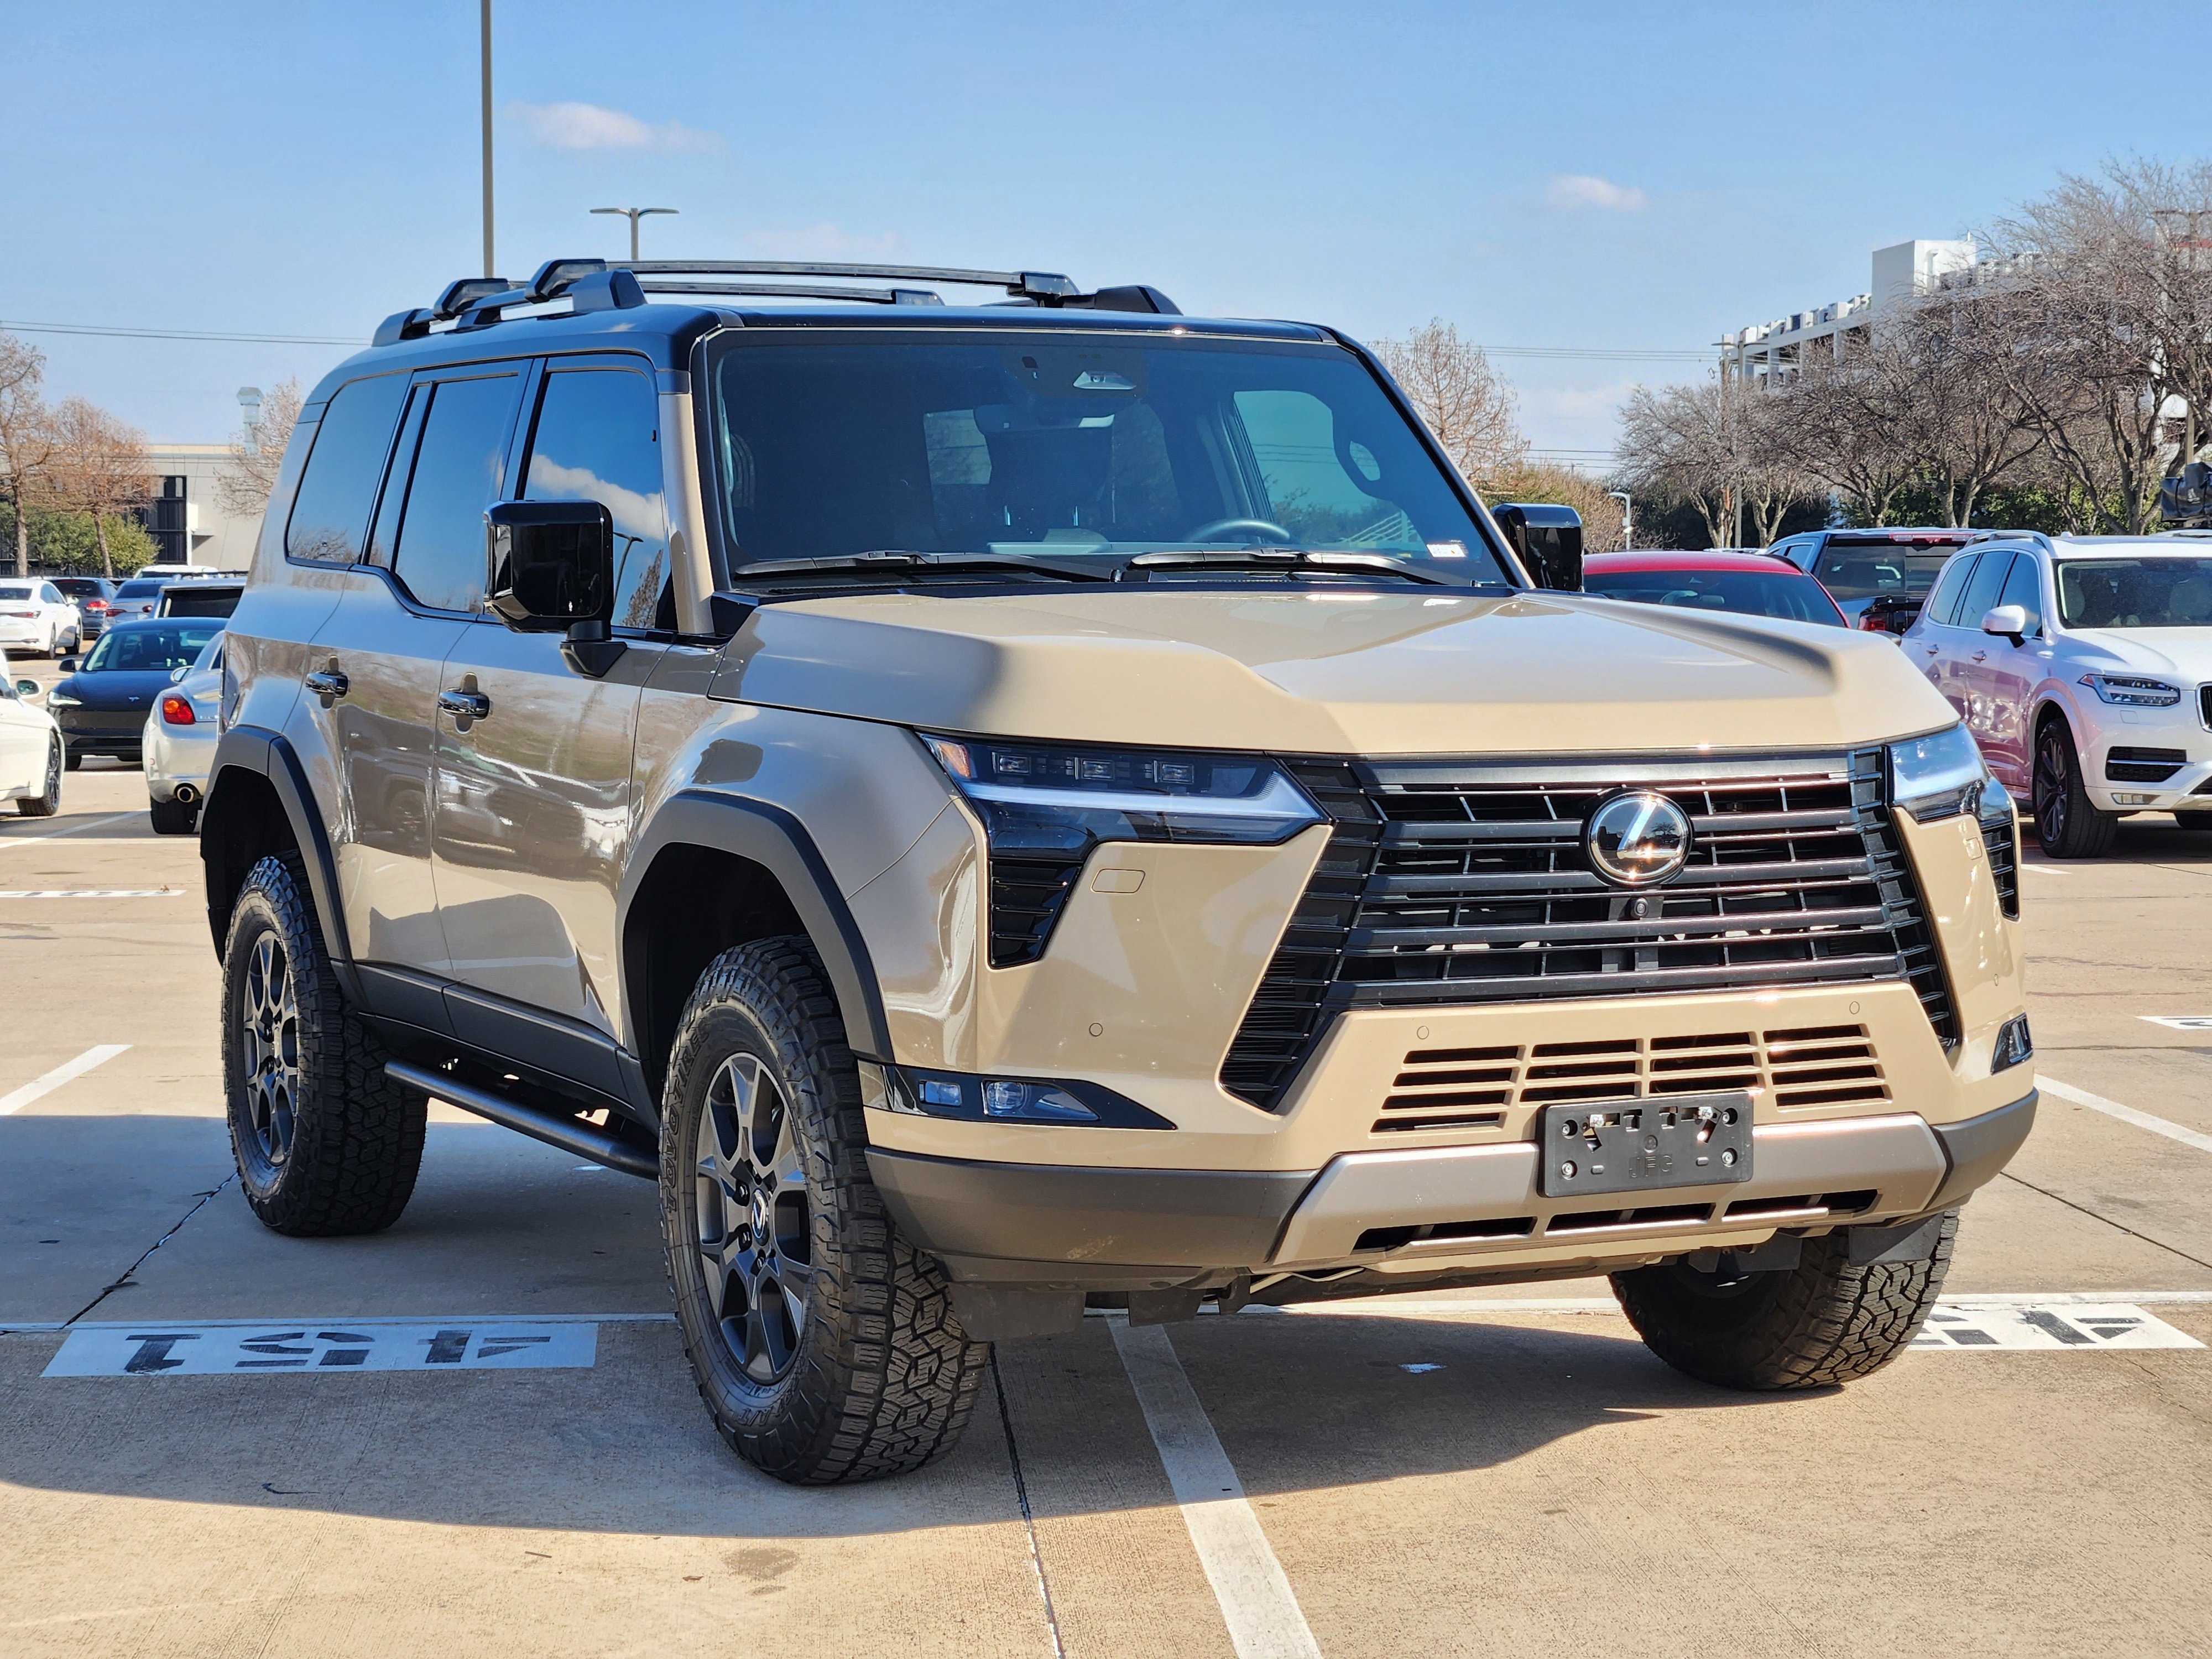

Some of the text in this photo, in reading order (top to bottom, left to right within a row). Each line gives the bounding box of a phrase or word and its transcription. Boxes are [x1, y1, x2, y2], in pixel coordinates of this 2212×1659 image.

[665, 1105, 679, 1213] TOYO
[1629, 1154, 1673, 1178] JFG
[1908, 1310, 2145, 1346] 45
[122, 1328, 551, 1373] 451
